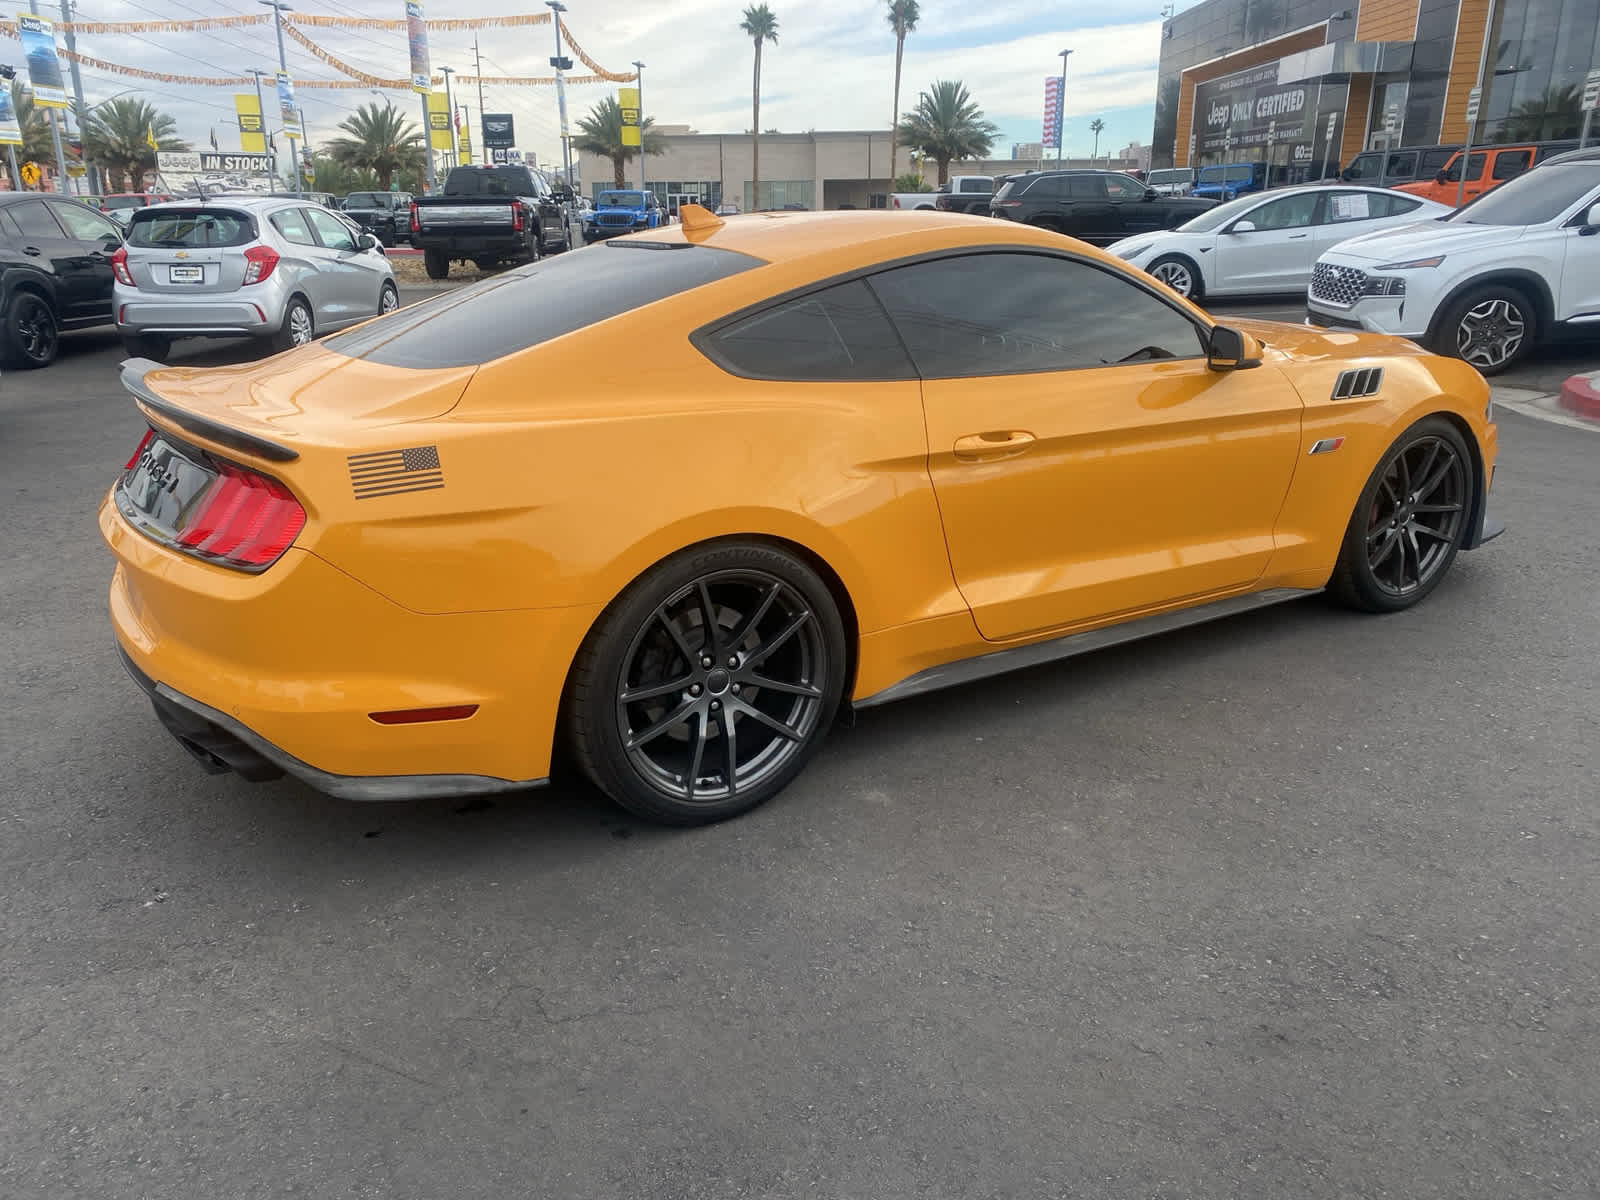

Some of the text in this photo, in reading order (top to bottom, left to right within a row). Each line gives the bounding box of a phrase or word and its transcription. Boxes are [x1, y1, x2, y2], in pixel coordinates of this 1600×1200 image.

[1208, 89, 1304, 127] Jeep ONLY CERTIFIED
[206, 156, 221, 169] IN
